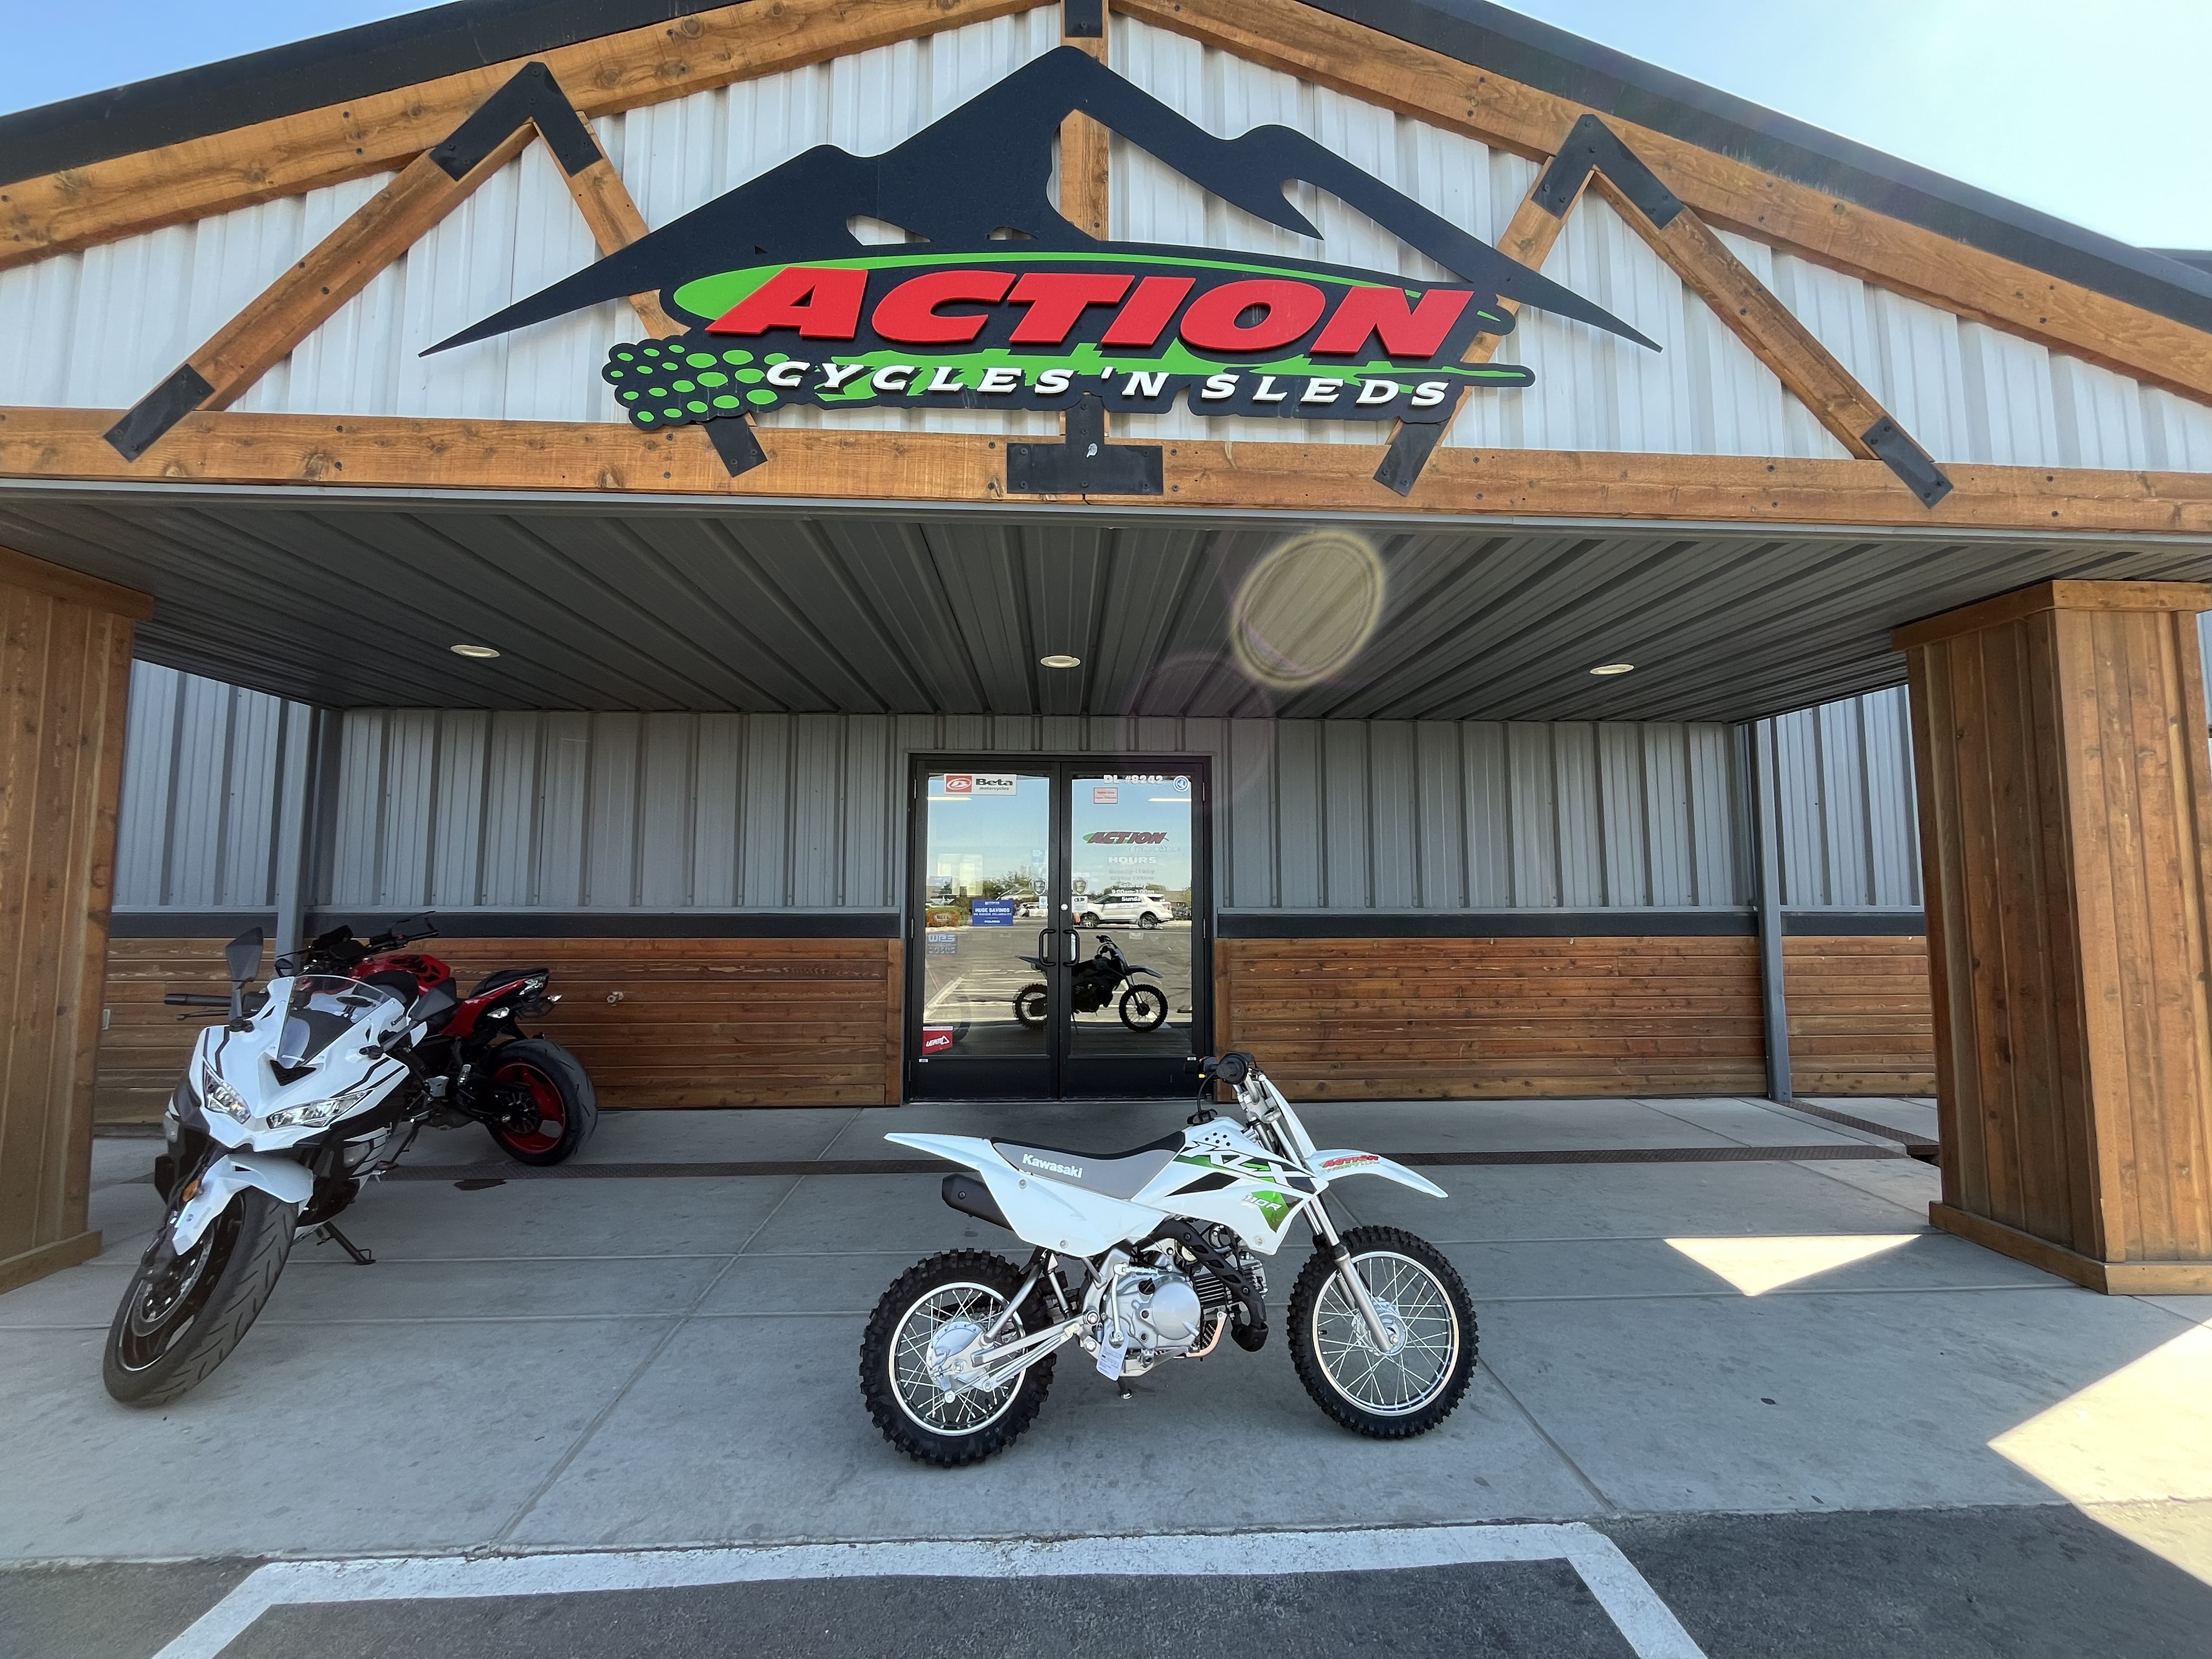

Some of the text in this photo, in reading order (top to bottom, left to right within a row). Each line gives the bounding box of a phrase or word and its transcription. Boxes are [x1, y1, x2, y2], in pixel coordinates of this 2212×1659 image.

[707, 267, 1472, 354] ACTION
[766, 361, 1449, 406] CYCLES 'N SLEDS
[1103, 775, 1120, 785] DL
[1125, 775, 1164, 785] #8242
[1086, 832, 1167, 844] ACTION
[928, 934, 956, 943] WPS
[1022, 1153, 1084, 1178] Kawasaki
[1322, 1155, 1380, 1168] ACTION
[1242, 1194, 1282, 1211] 110R
